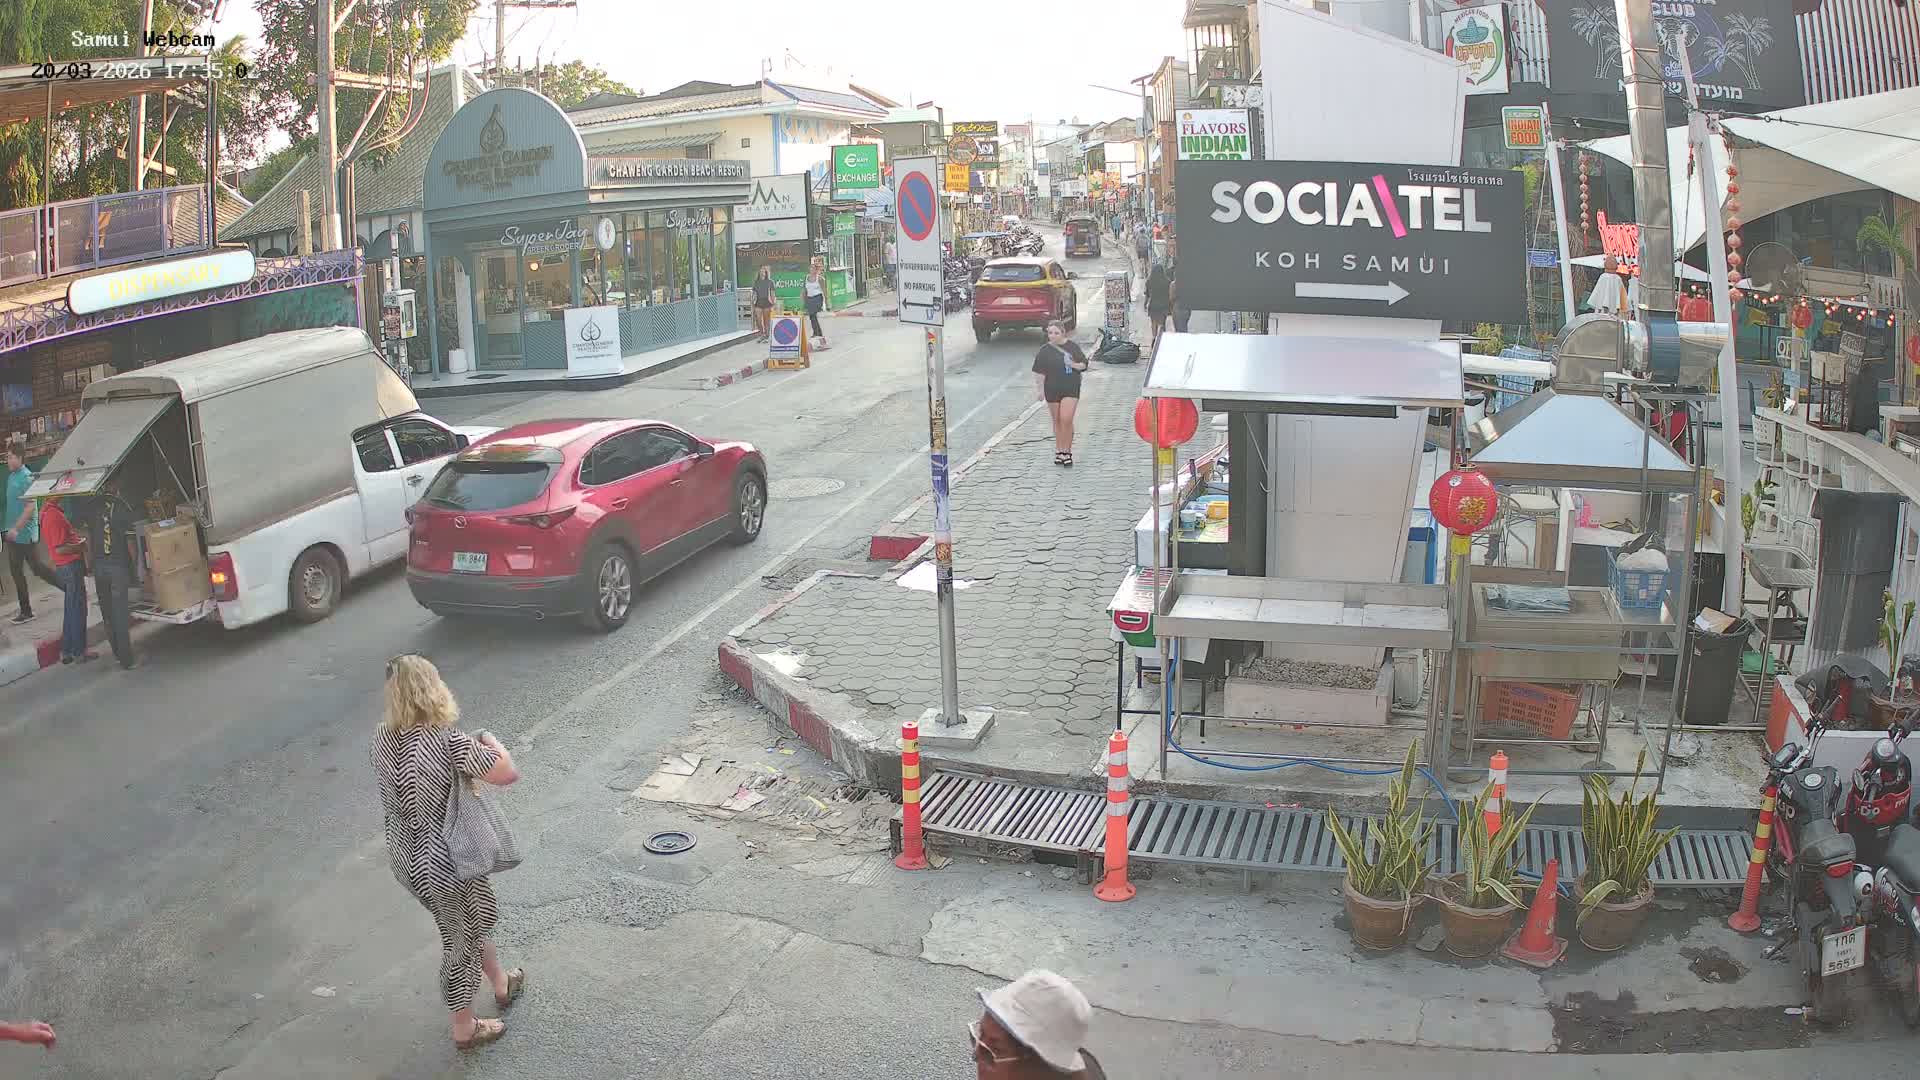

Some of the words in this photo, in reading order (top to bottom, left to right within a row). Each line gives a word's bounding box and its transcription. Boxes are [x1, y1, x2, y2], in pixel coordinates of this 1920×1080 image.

[1455, 9, 1475, 23] MEXICAN
[1476, 9, 1489, 20] FOOD
[1183, 123, 1246, 135] FLAVORS
[1507, 119, 1541, 130] INDIAN
[1181, 135, 1247, 152] INDIAN
[1511, 132, 1538, 145] FOOD
[609, 164, 653, 177] CHAWENG
[656, 165, 689, 177] GARDEN
[691, 164, 716, 176] BEACH
[718, 164, 745, 176] RESORT
[837, 173, 877, 183] EXCHANGE
[1255, 251, 1321, 269] KOH
[1343, 253, 1449, 275] SAMUI
[108, 264, 223, 301] DISPENSARY
[904, 282, 912, 290] NO
[912, 282, 936, 292] PARKING
